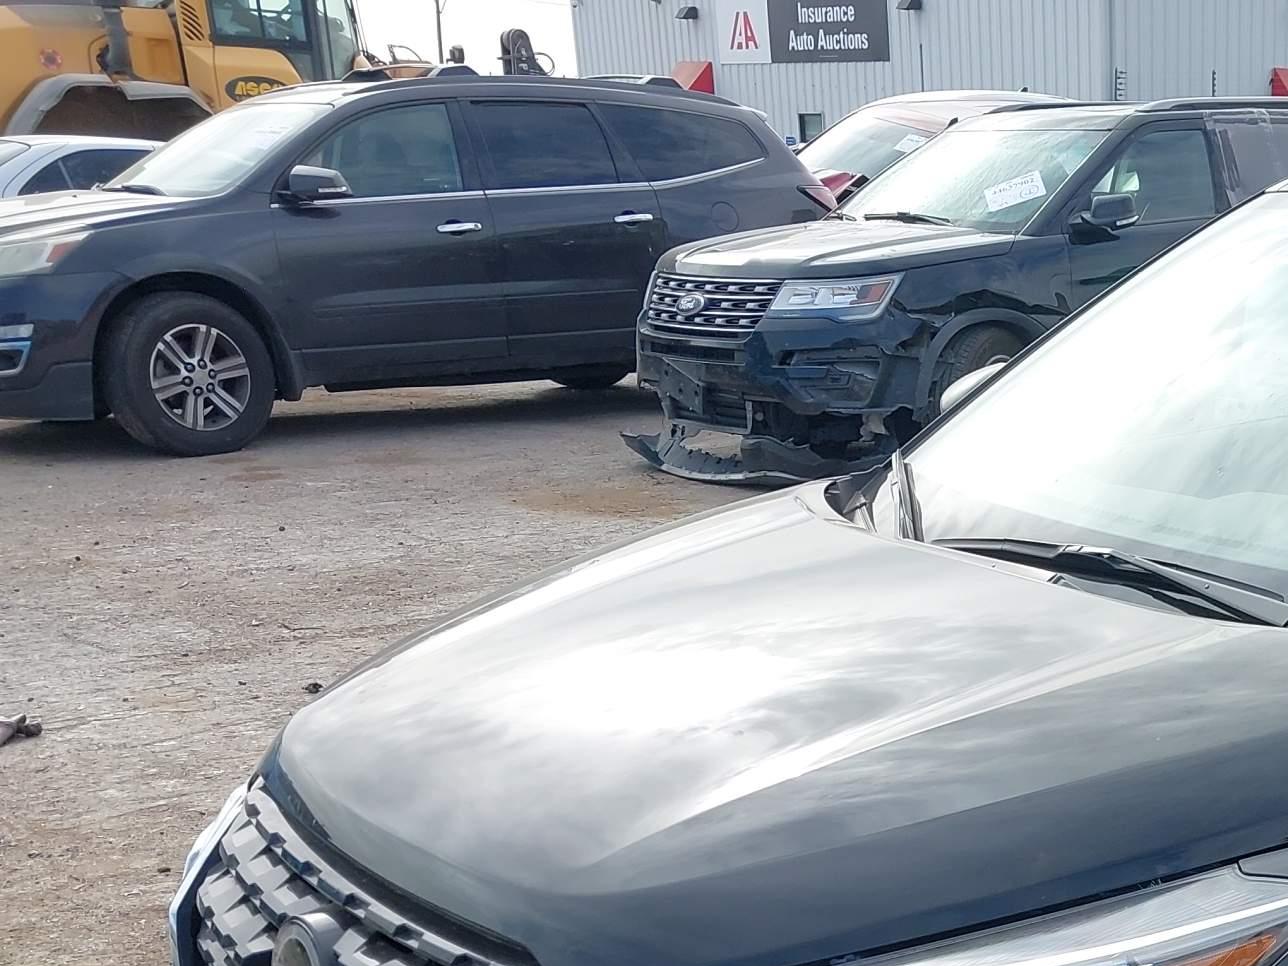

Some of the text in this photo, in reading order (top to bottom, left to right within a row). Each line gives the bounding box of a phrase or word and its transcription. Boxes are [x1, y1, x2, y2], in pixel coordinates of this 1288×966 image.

[797, 2, 856, 24] Insurance
[788, 28, 869, 51] Auto Auctions
